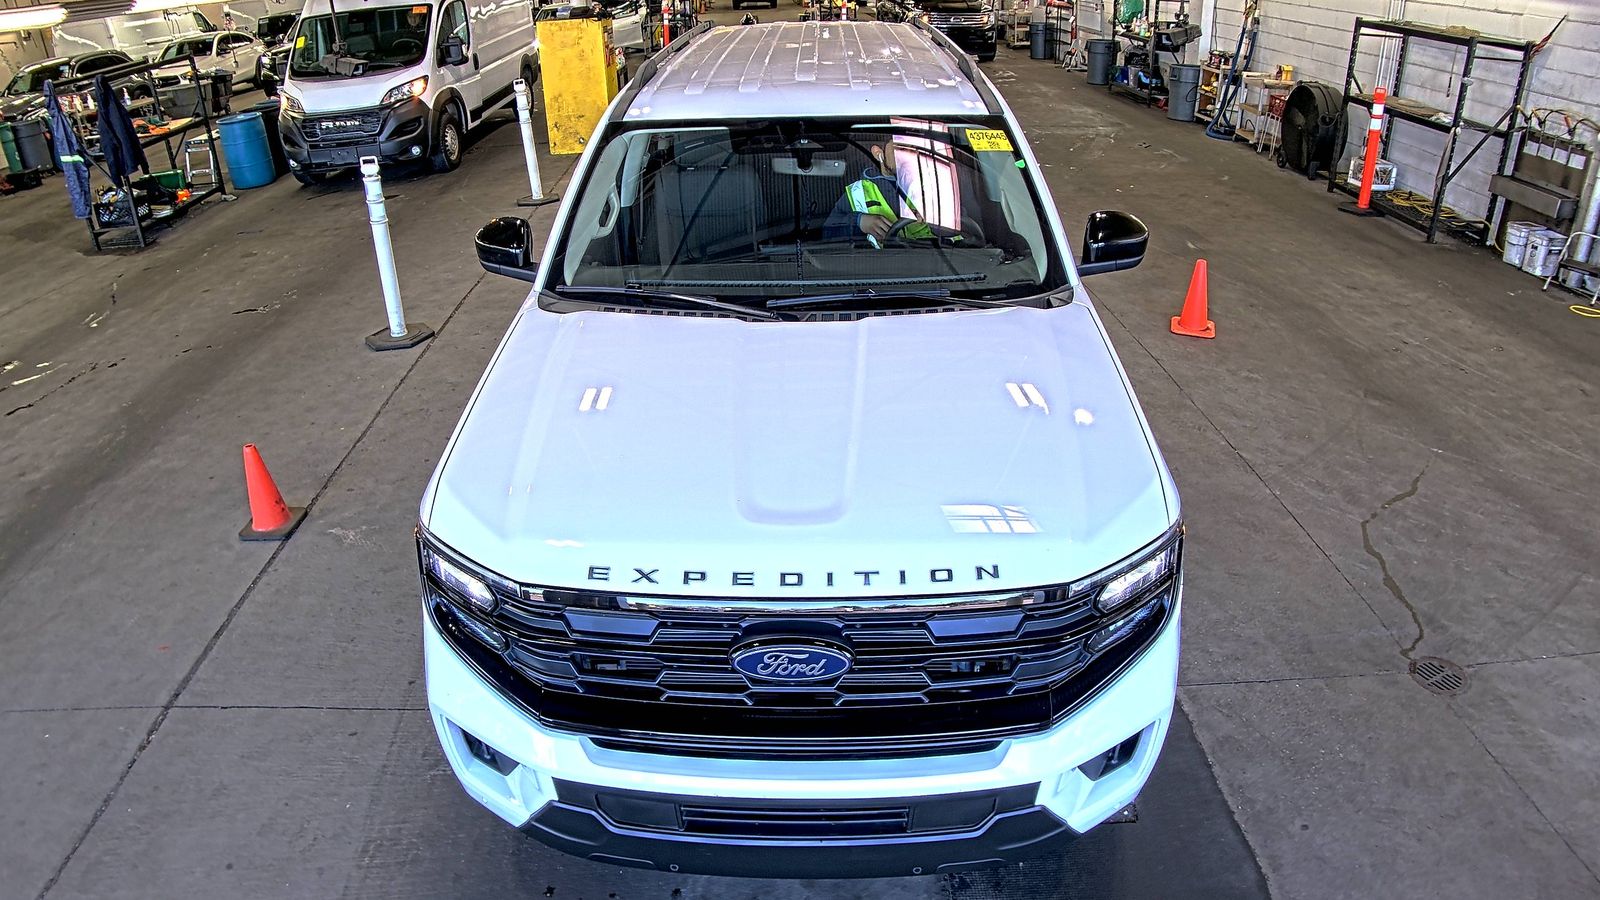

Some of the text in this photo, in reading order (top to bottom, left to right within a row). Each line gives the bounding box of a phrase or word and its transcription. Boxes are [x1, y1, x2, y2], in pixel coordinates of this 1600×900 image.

[970, 131, 1008, 141] 4376445
[587, 564, 1000, 587] EXPEDITION
[756, 652, 828, 676] Ford
